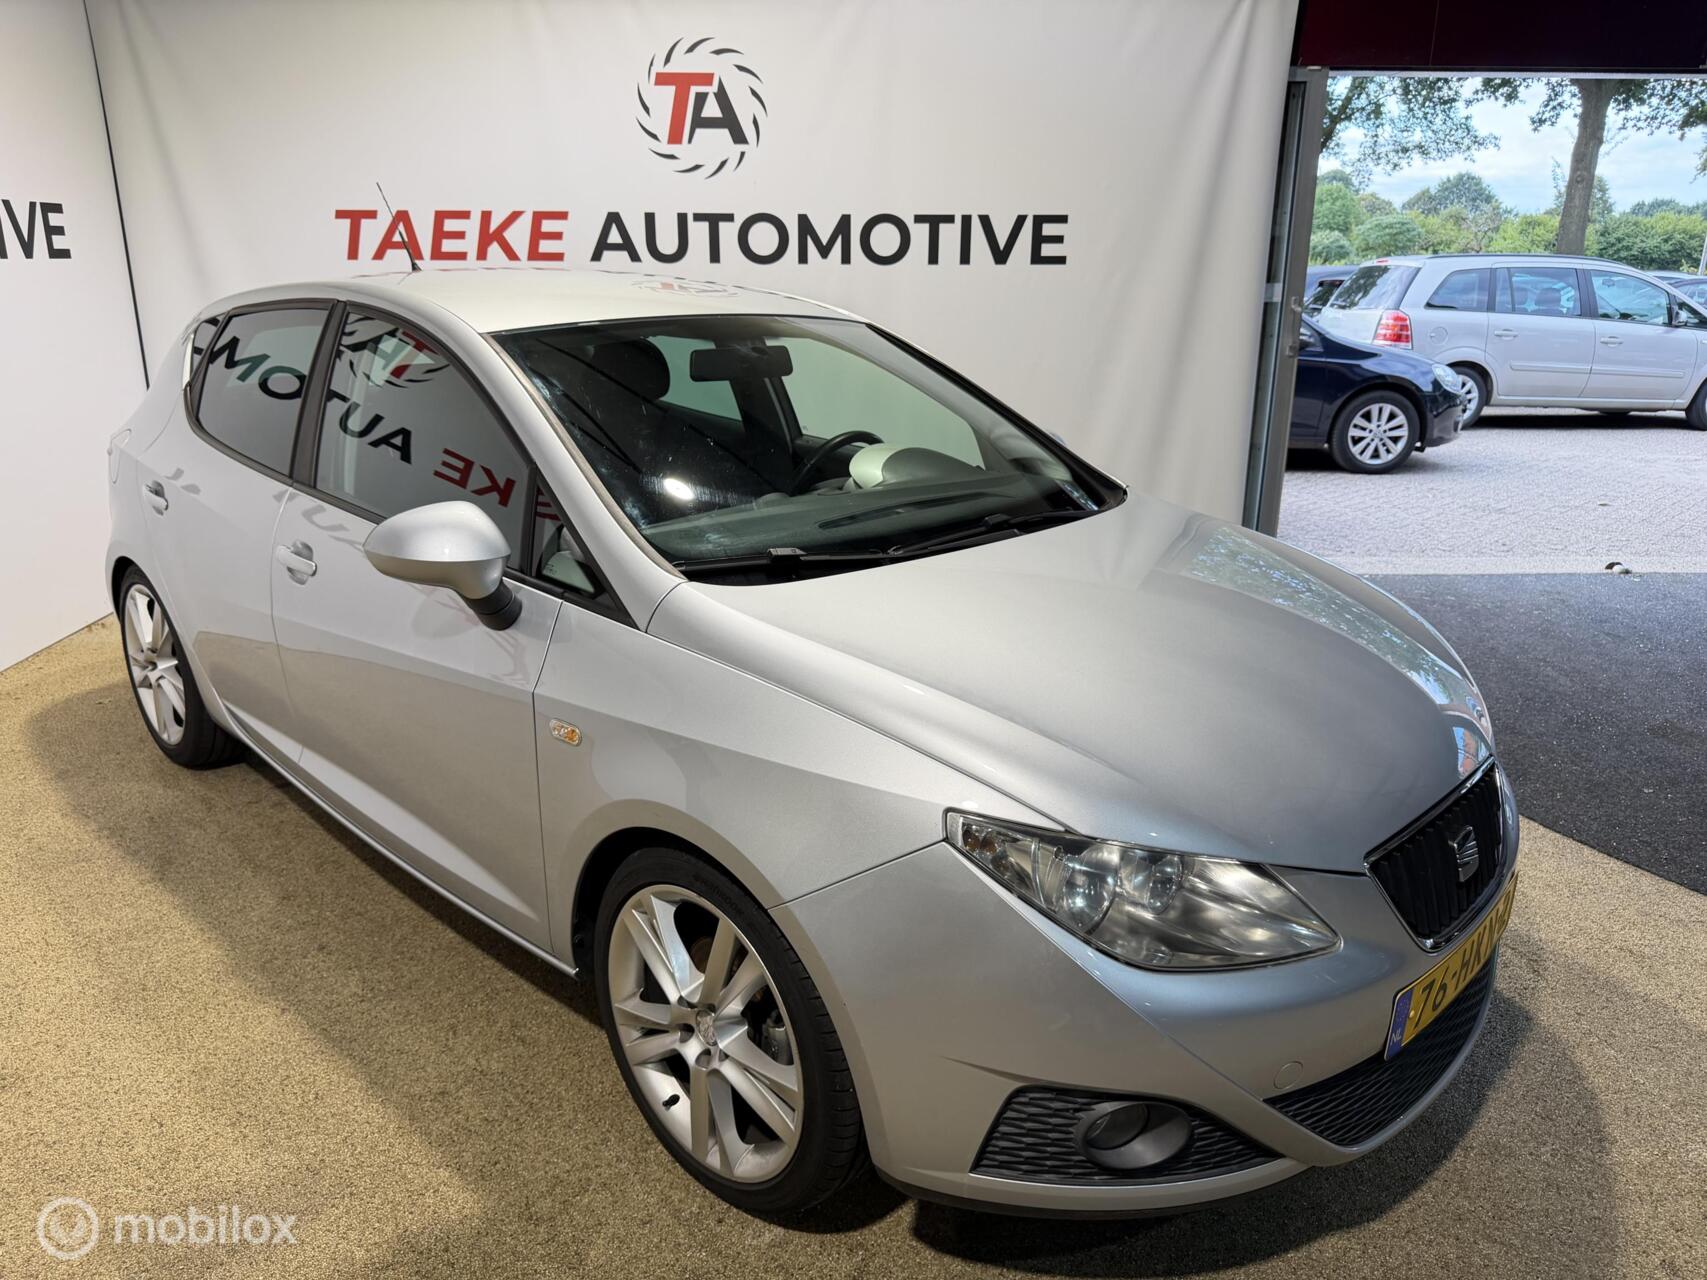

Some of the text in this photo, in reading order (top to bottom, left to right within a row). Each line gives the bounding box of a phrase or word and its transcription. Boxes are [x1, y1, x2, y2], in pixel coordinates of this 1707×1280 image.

[654, 72, 749, 144] TA
[335, 209, 1069, 266] TAEKE AUTOMOTIVE
